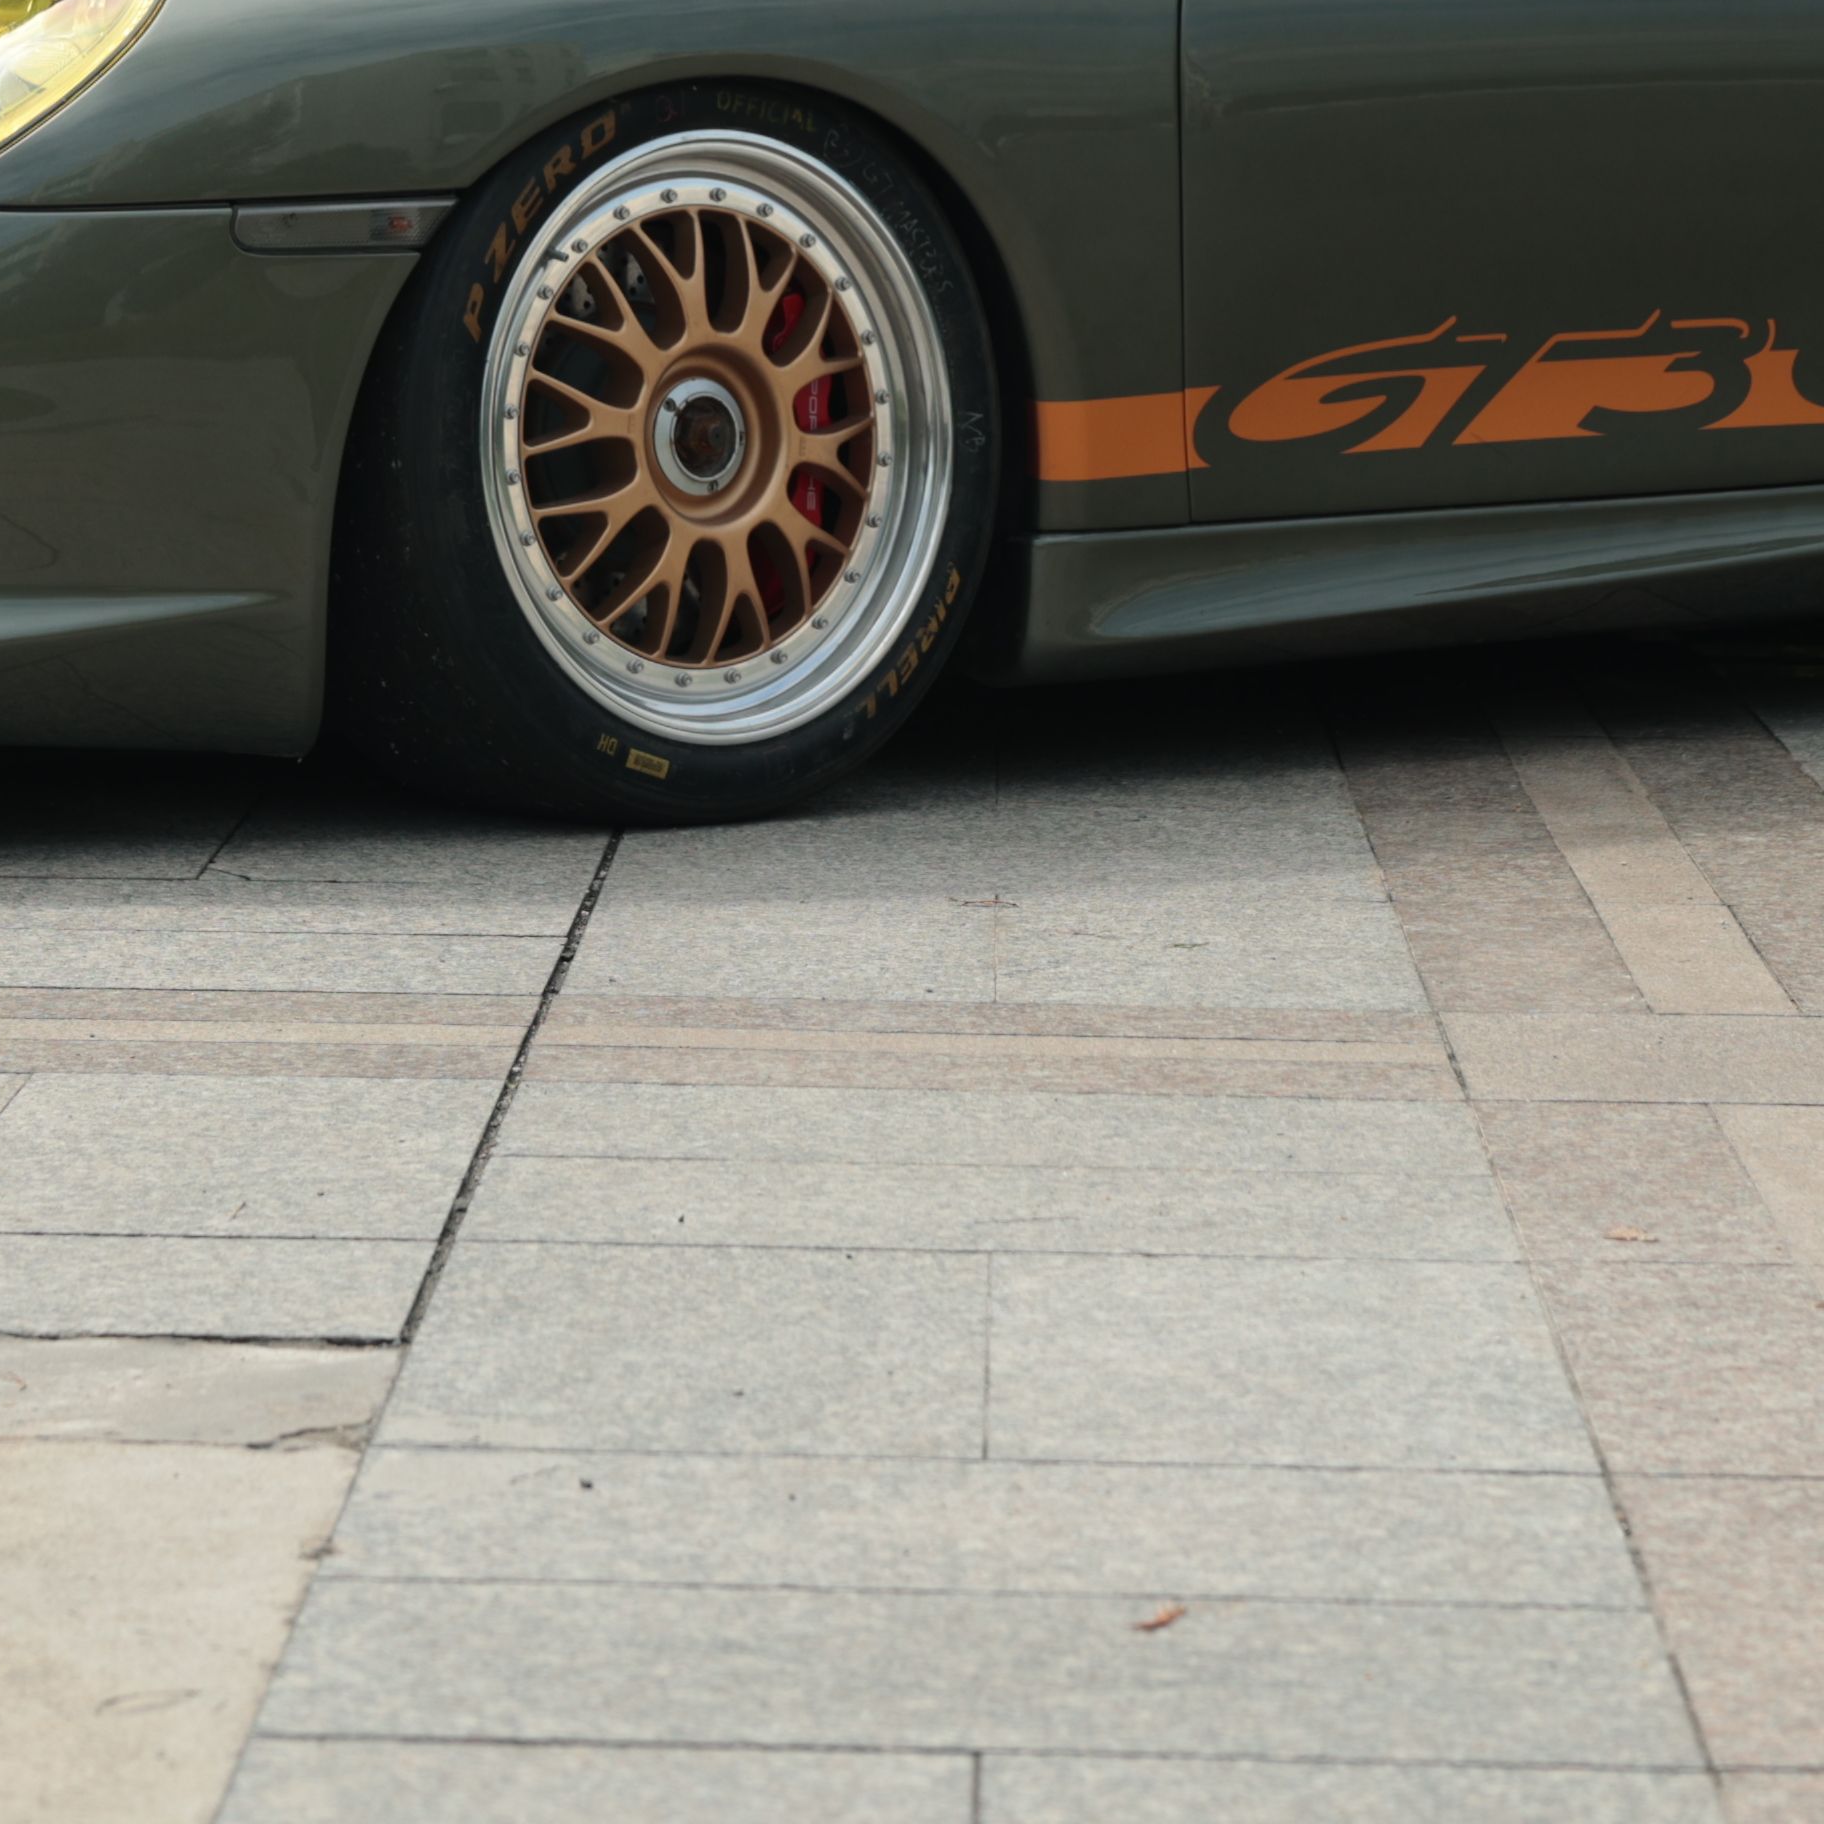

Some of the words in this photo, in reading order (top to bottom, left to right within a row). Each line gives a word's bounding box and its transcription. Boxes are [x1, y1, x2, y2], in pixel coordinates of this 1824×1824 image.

[715, 89, 816, 134] OFFICIAL
[462, 280, 486, 343] P
[483, 108, 618, 285] ZERO
[805, 379, 819, 512] PORHE
[1192, 309, 1775, 455] GT3
